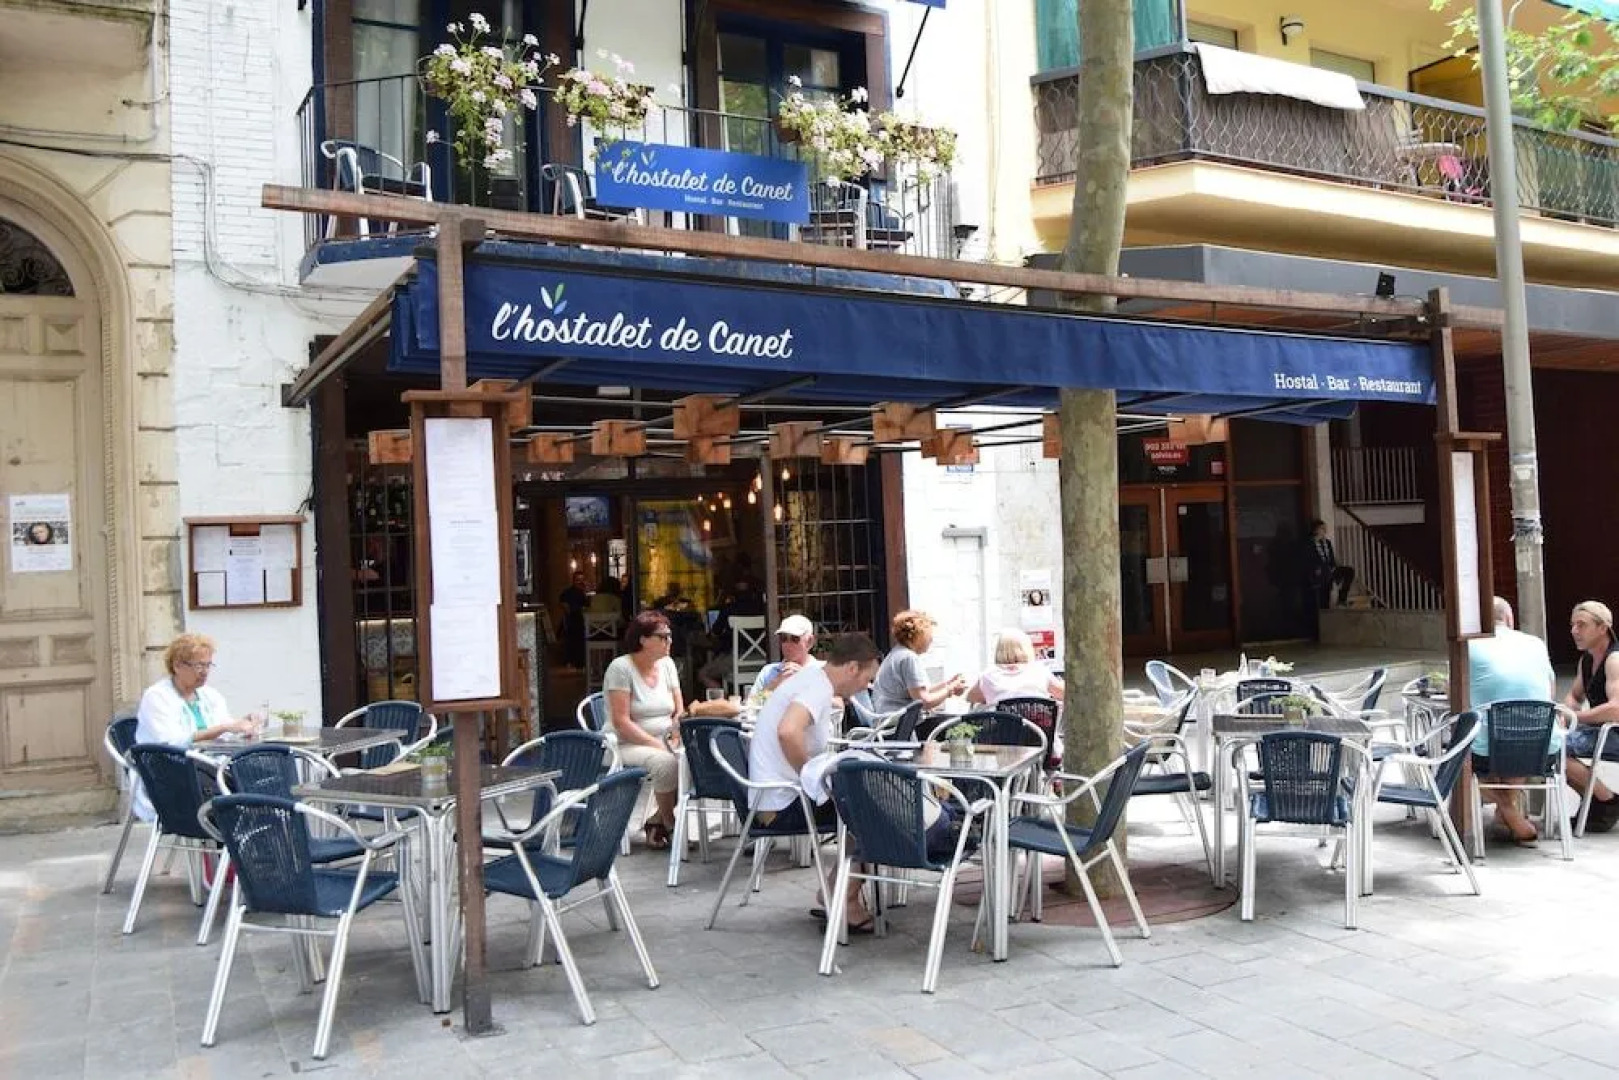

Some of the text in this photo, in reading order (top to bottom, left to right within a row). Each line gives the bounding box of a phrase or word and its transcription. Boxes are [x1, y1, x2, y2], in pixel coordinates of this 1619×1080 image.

[611, 160, 793, 201] l'hostalet de Canet
[492, 302, 793, 359] l'hostalet de Canet
[1273, 373, 1422, 395] Hostal Bar Restaurant
